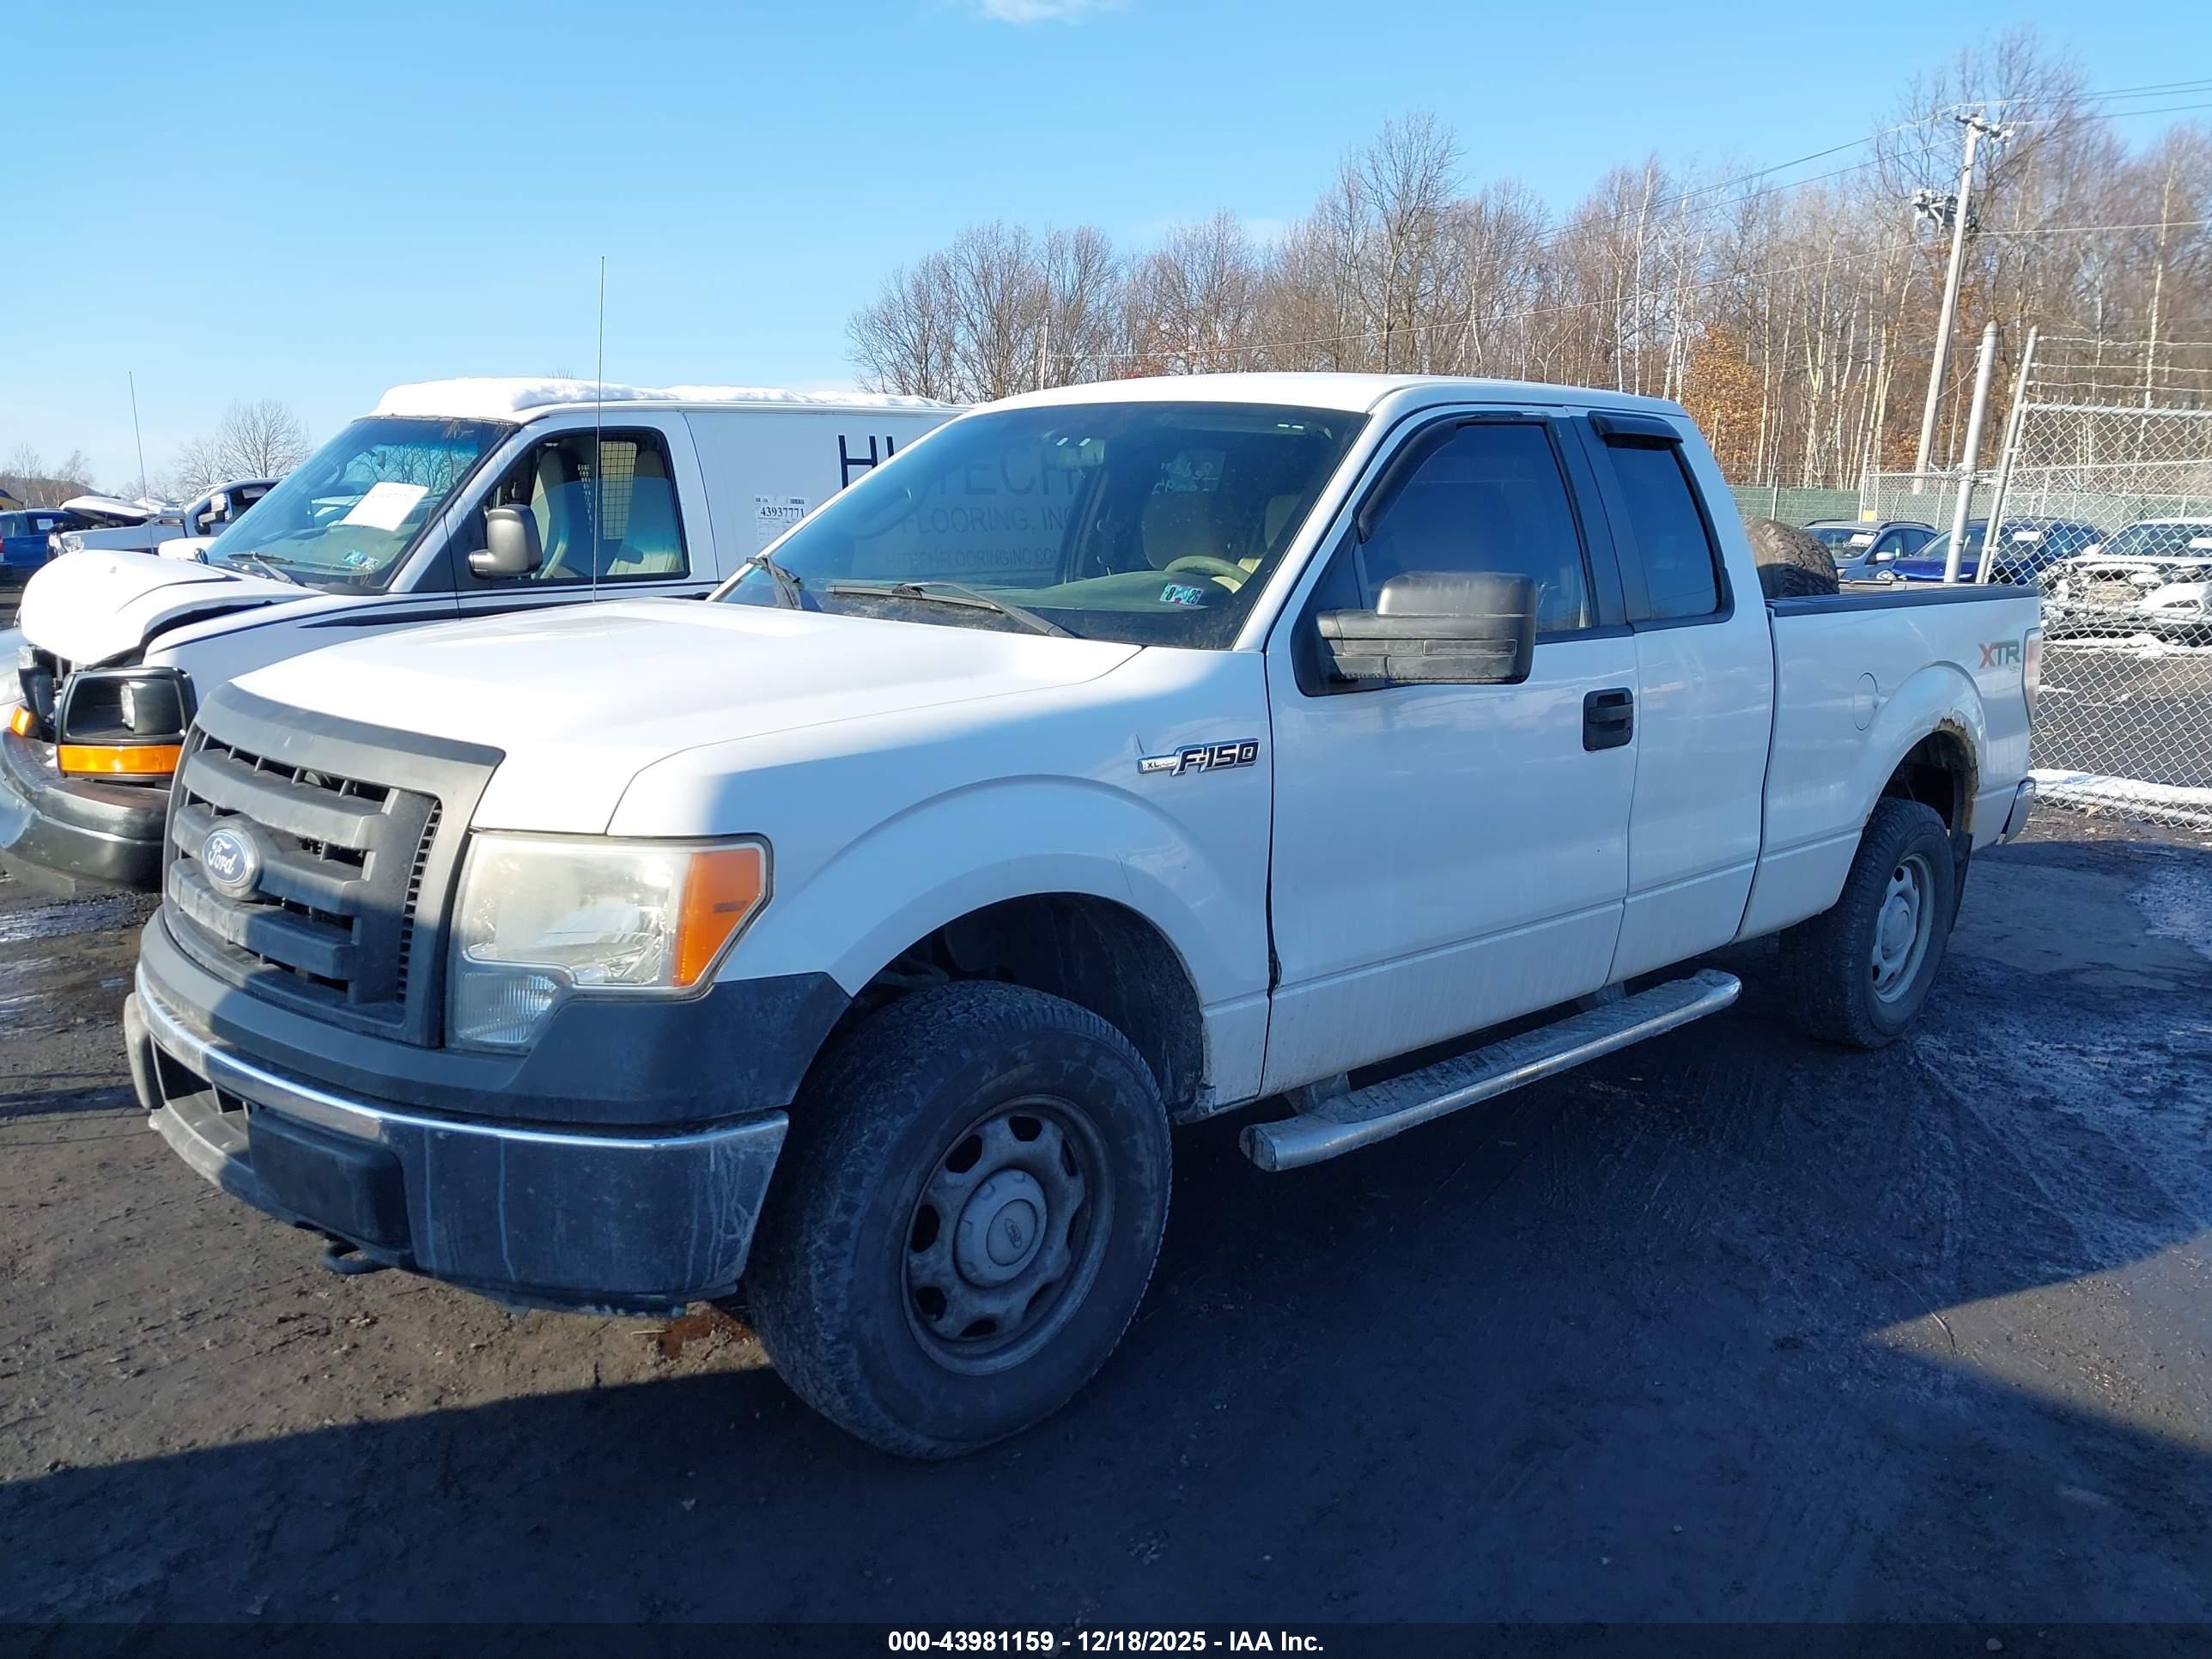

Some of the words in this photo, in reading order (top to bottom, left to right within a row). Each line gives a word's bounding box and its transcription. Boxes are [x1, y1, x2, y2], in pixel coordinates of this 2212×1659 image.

[760, 505, 805, 518] 43937771
[1165, 586, 1176, 601] 8
[1186, 589, 1201, 605] 26
[1978, 639, 2021, 669] XTR
[1146, 761, 1159, 769] XL
[207, 837, 237, 875] Ford
